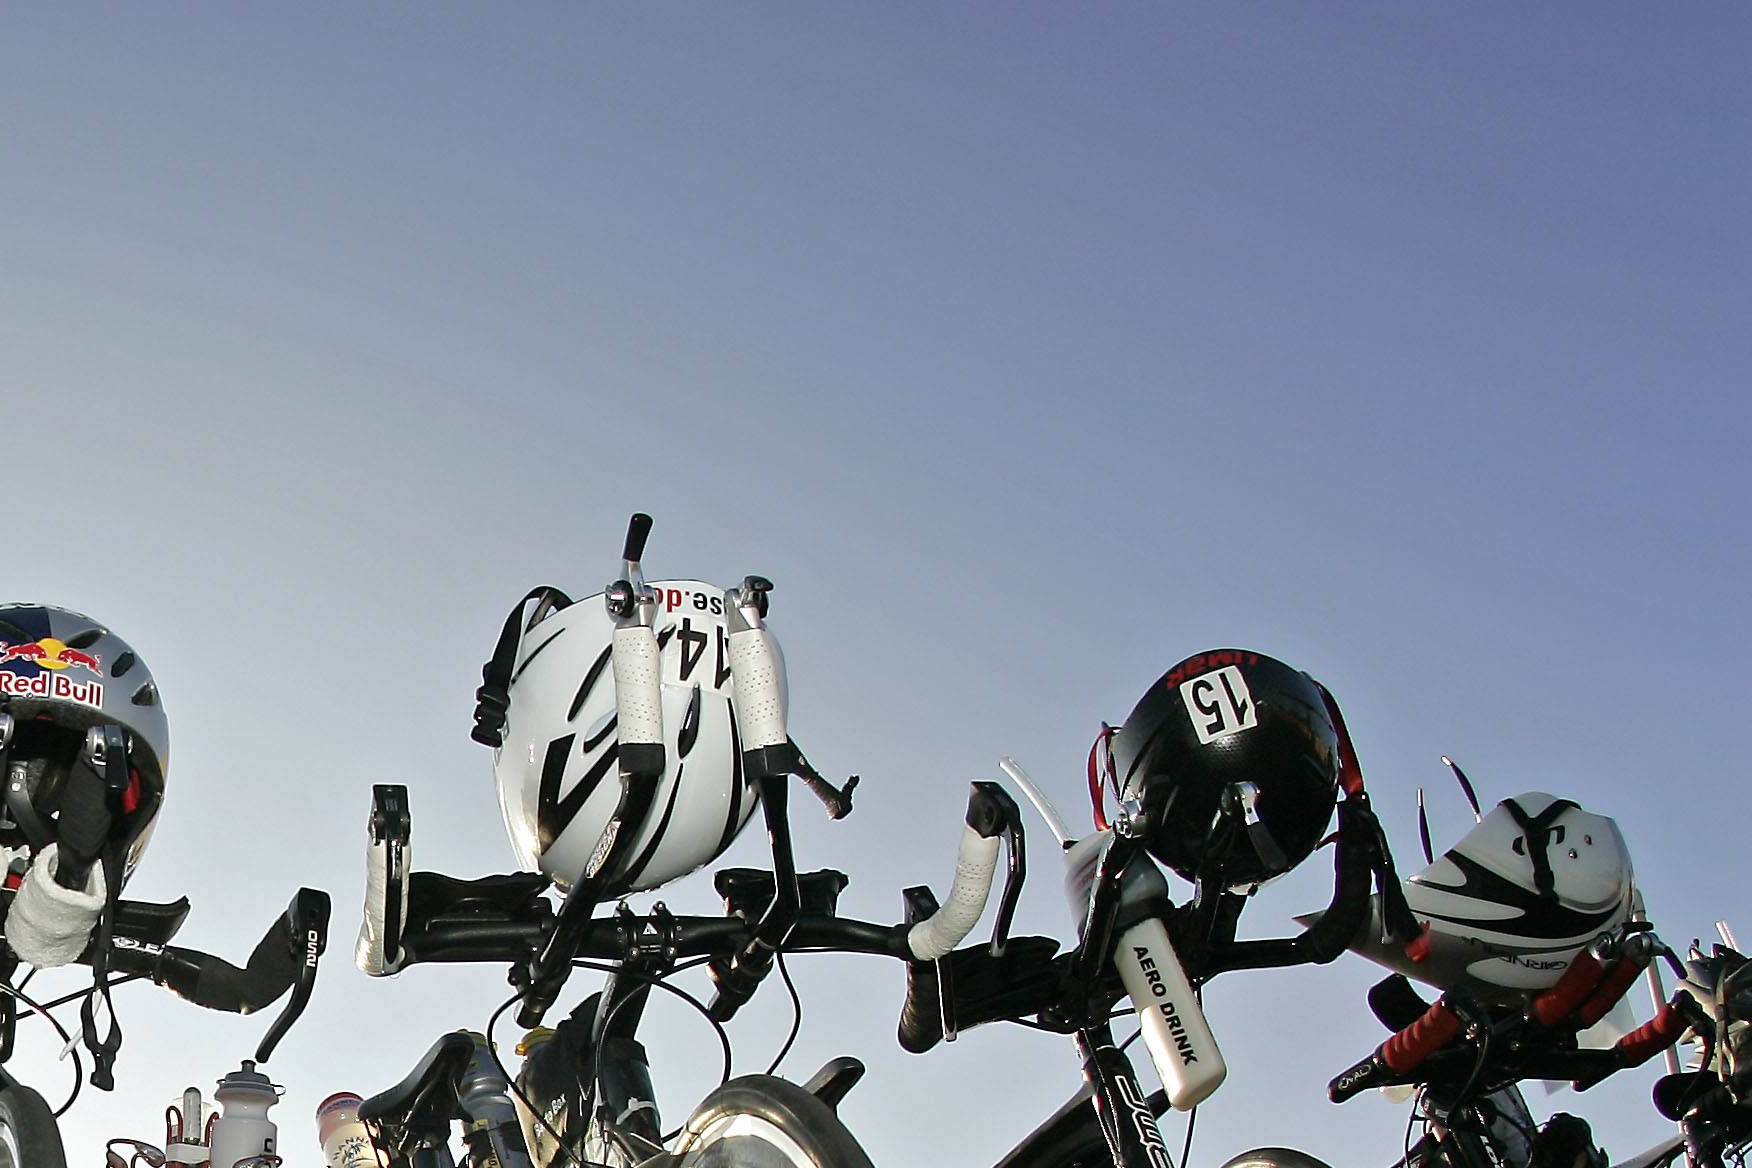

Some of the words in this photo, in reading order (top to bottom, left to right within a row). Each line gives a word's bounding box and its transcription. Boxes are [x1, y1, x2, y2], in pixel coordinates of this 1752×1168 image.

[52, 673, 104, 710] Bull
[1192, 671, 1249, 736] 15
[1133, 946, 1168, 997] AERO
[1159, 1002, 1199, 1067] DRINK
